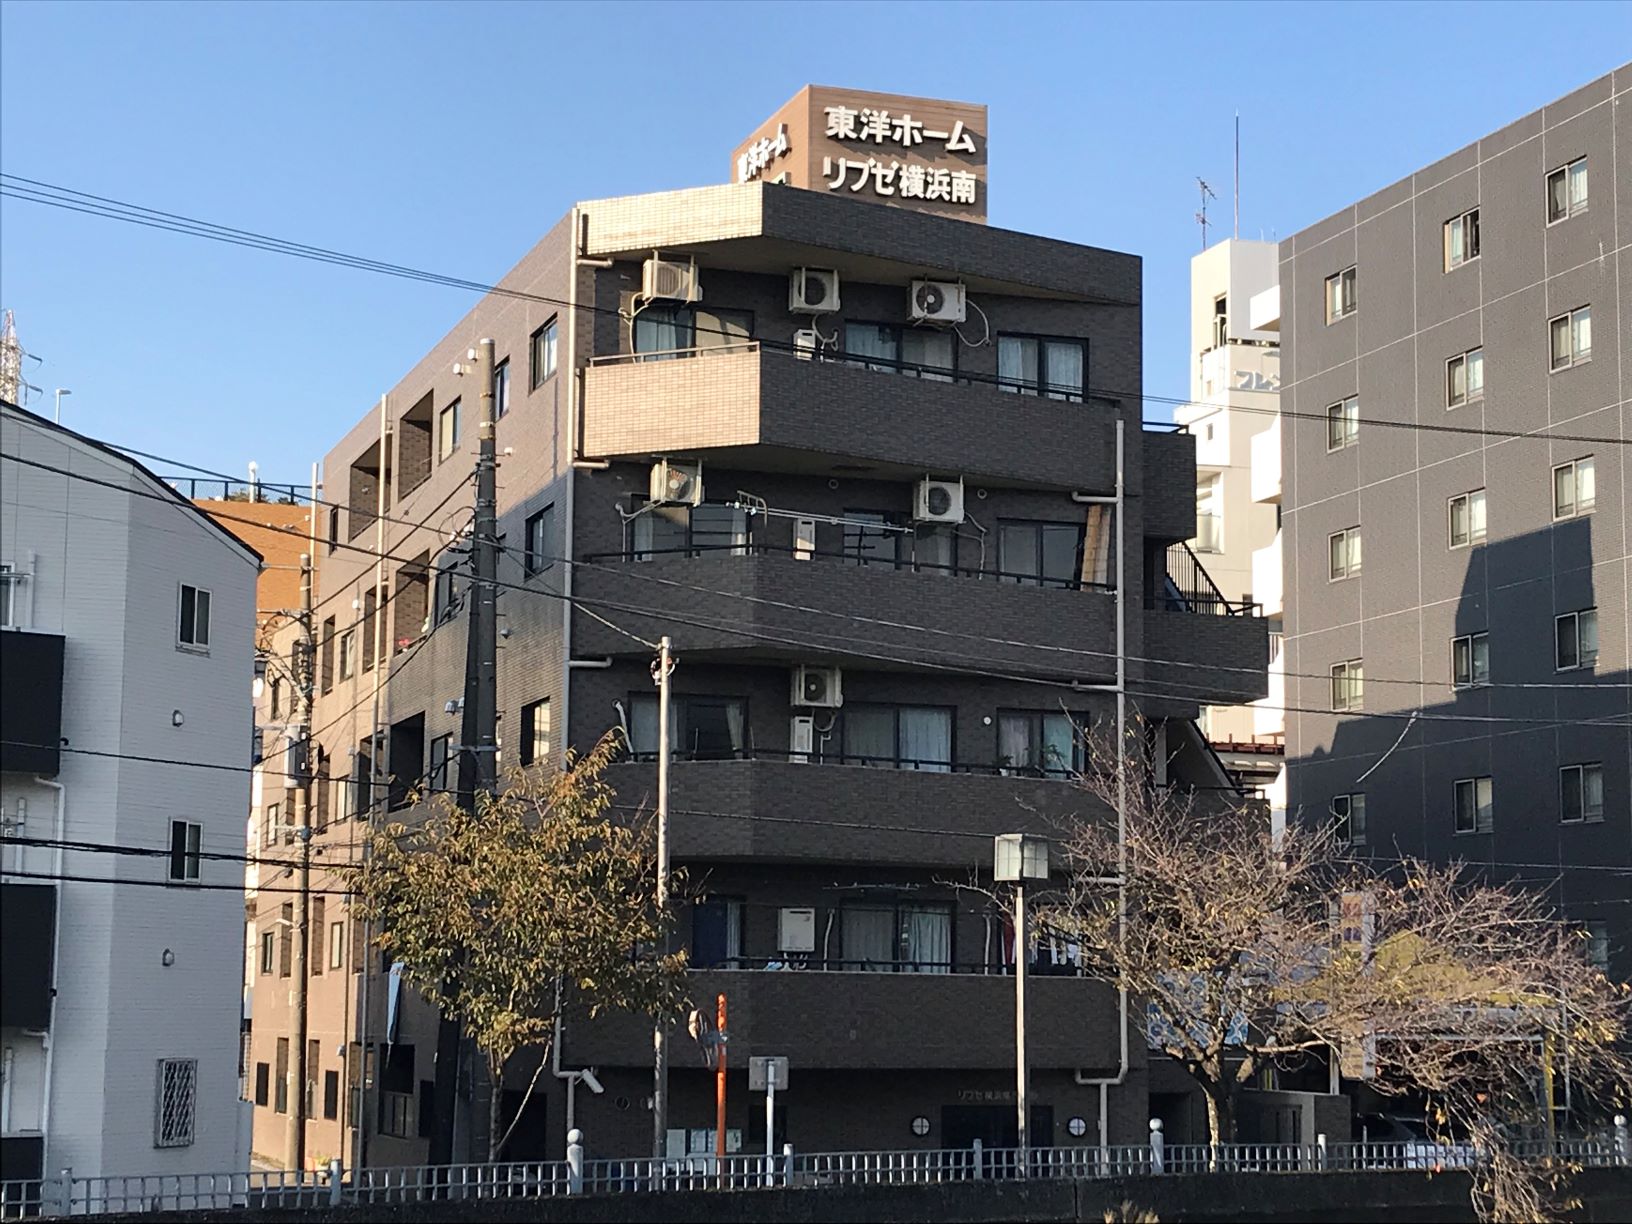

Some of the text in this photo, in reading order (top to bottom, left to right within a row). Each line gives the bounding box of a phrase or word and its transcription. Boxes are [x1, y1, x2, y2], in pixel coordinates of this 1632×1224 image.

[824, 105, 977, 154] 東洋ホーム
[822, 156, 977, 204] リブゼ横浜南
